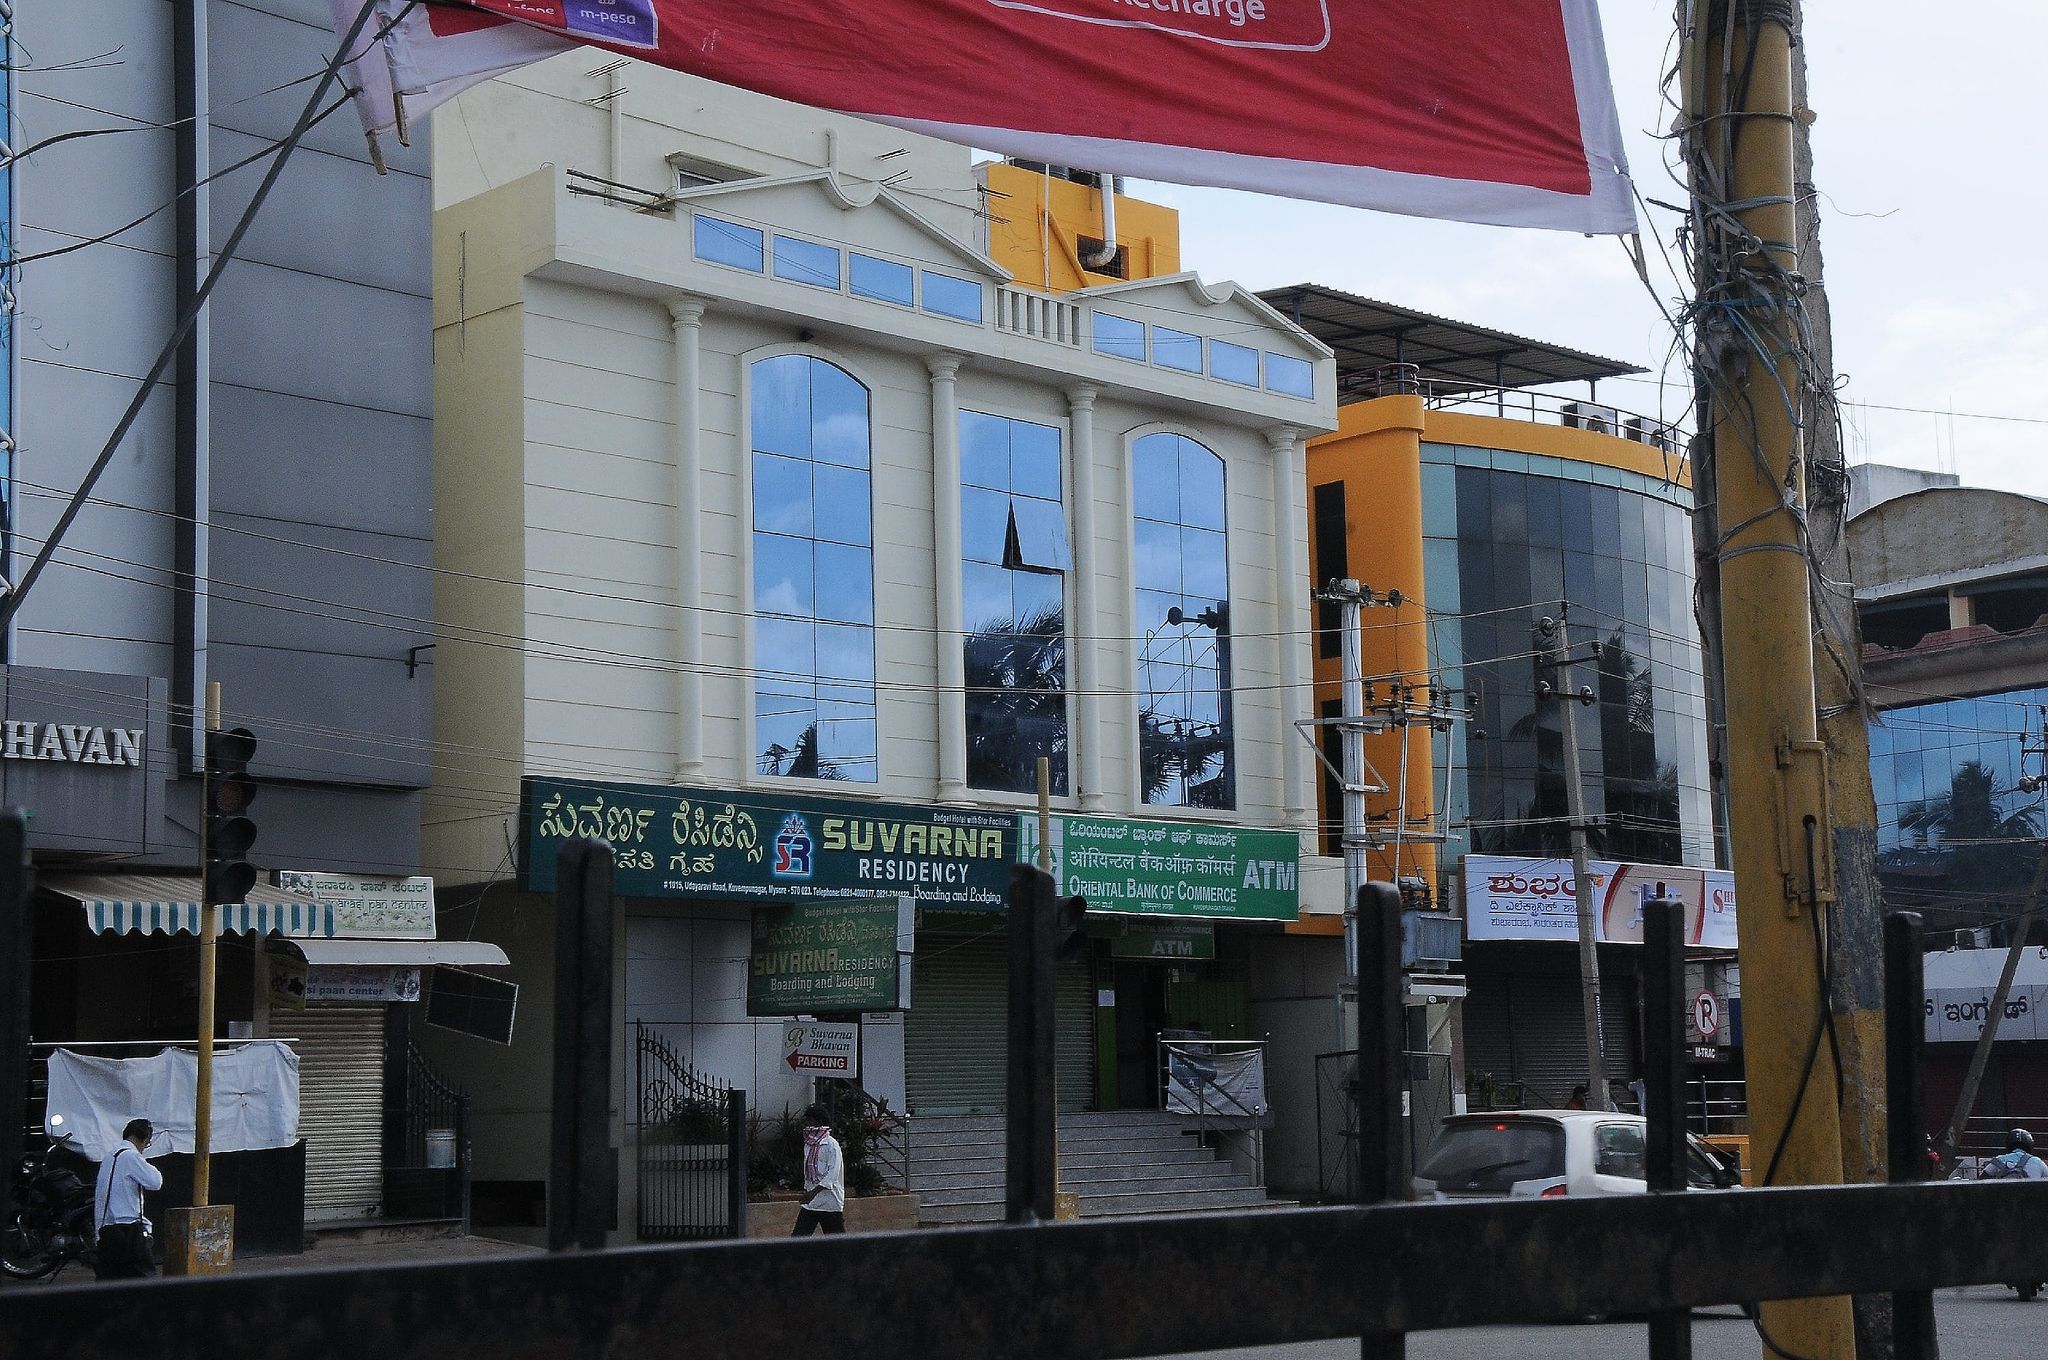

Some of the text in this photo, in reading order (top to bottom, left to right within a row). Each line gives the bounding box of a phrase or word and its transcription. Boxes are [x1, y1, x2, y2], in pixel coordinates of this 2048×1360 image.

[580, 9, 636, 25] m-pesa
[0, 720, 144, 767] HAVAN
[539, 792, 656, 844] ಸುವರ್ಣ
[823, 818, 1003, 860] SUVARNA
[611, 848, 716, 877] ಸತಿ ಗೃಹ
[859, 858, 970, 884] RESIDENCY
[1242, 859, 1296, 891] ATM
[768, 885, 787, 896] Mysore
[913, 884, 1002, 905] Boarding and Lodging
[1126, 878, 1159, 900] BANK
[1177, 880, 1237, 903] COMMERCE
[368, 899, 389, 915] pan
[1152, 940, 1193, 956] ATM
[754, 948, 895, 976] SUVARNA RESIDENCY
[319, 987, 345, 997] paan
[348, 987, 384, 996] center
[770, 973, 876, 993] Boarding and Lodging
[809, 1027, 853, 1040] Suvarna
[810, 1039, 850, 1051] Bhavan
[797, 1055, 845, 1069] PARKING
